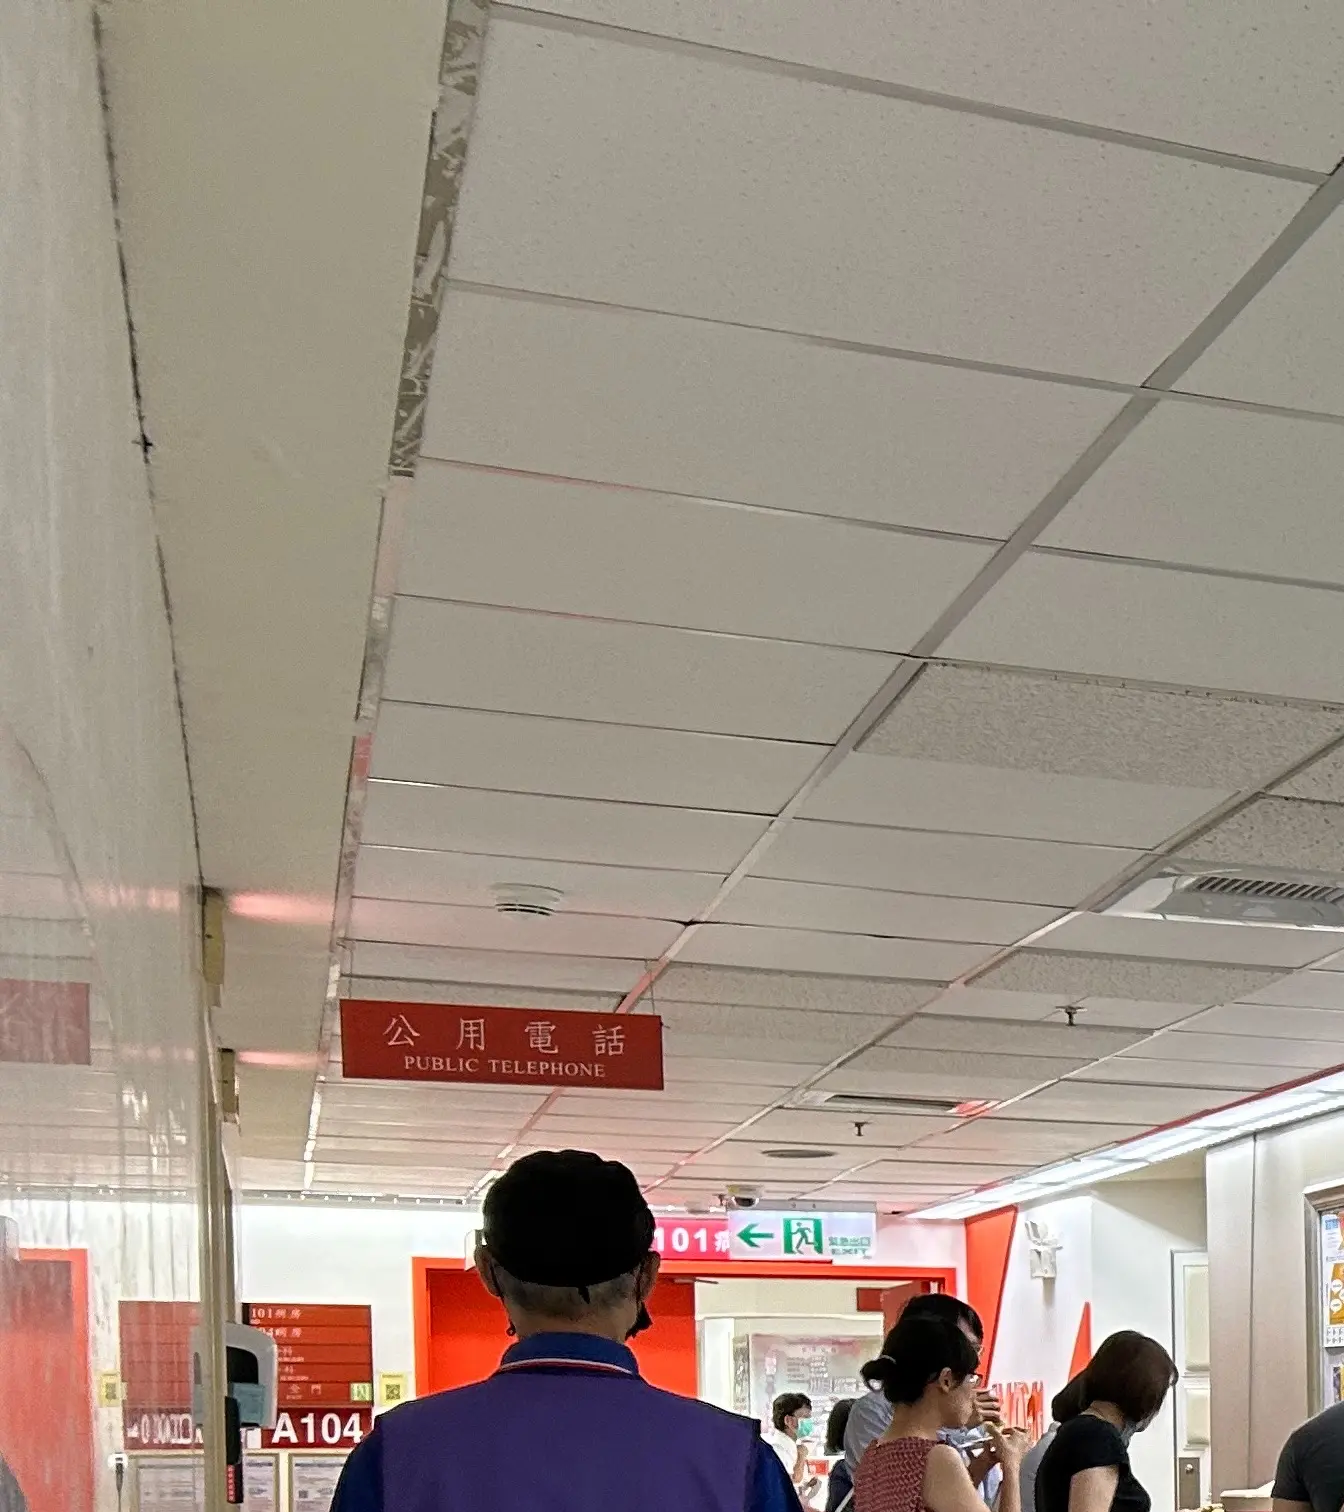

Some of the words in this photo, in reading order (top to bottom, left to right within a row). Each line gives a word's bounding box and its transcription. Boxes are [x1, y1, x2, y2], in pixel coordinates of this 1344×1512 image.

[383, 1013, 626, 1056] 公用電話
[404, 1055, 479, 1073] PUBLIC
[488, 1059, 606, 1078] TELEPHONE
[271, 1412, 364, 1444] A104
